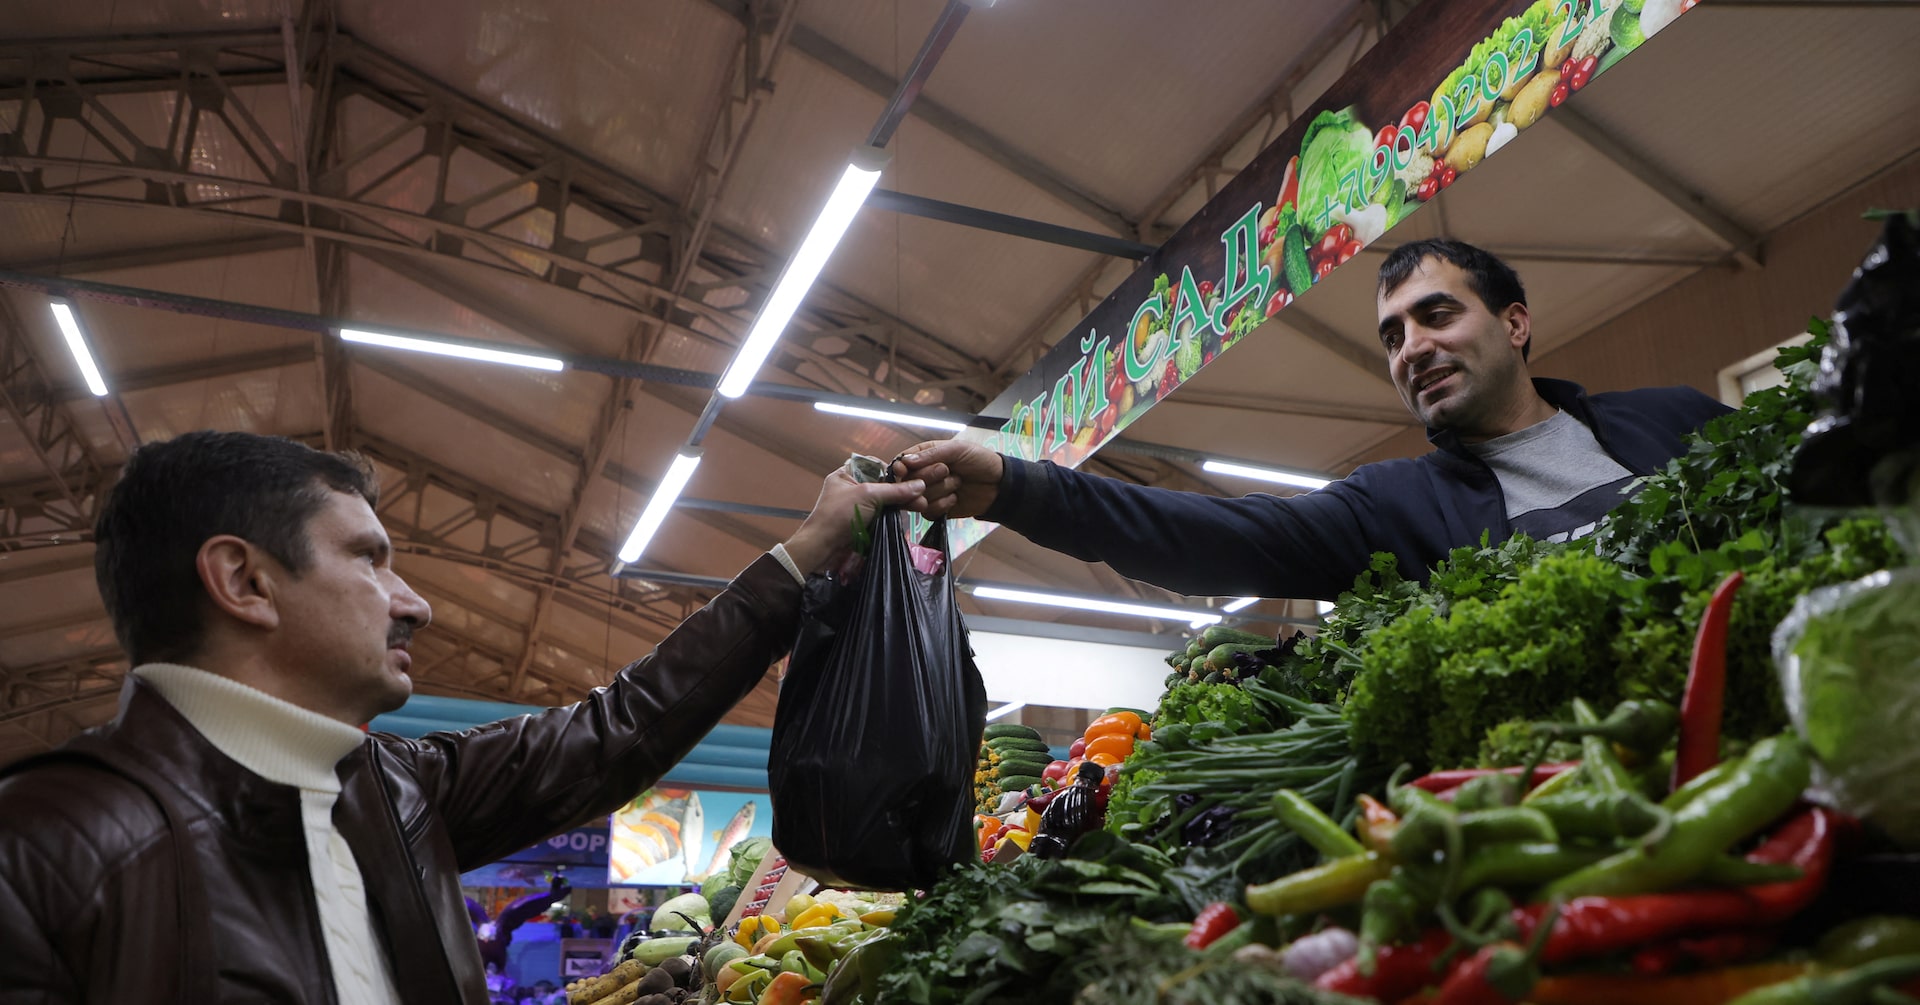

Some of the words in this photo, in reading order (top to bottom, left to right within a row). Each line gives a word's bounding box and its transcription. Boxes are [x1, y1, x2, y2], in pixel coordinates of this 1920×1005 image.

[1315, 27, 1539, 229] +7(904)202
[1124, 202, 1271, 382] САД
[547, 832, 609, 854] ФОР
